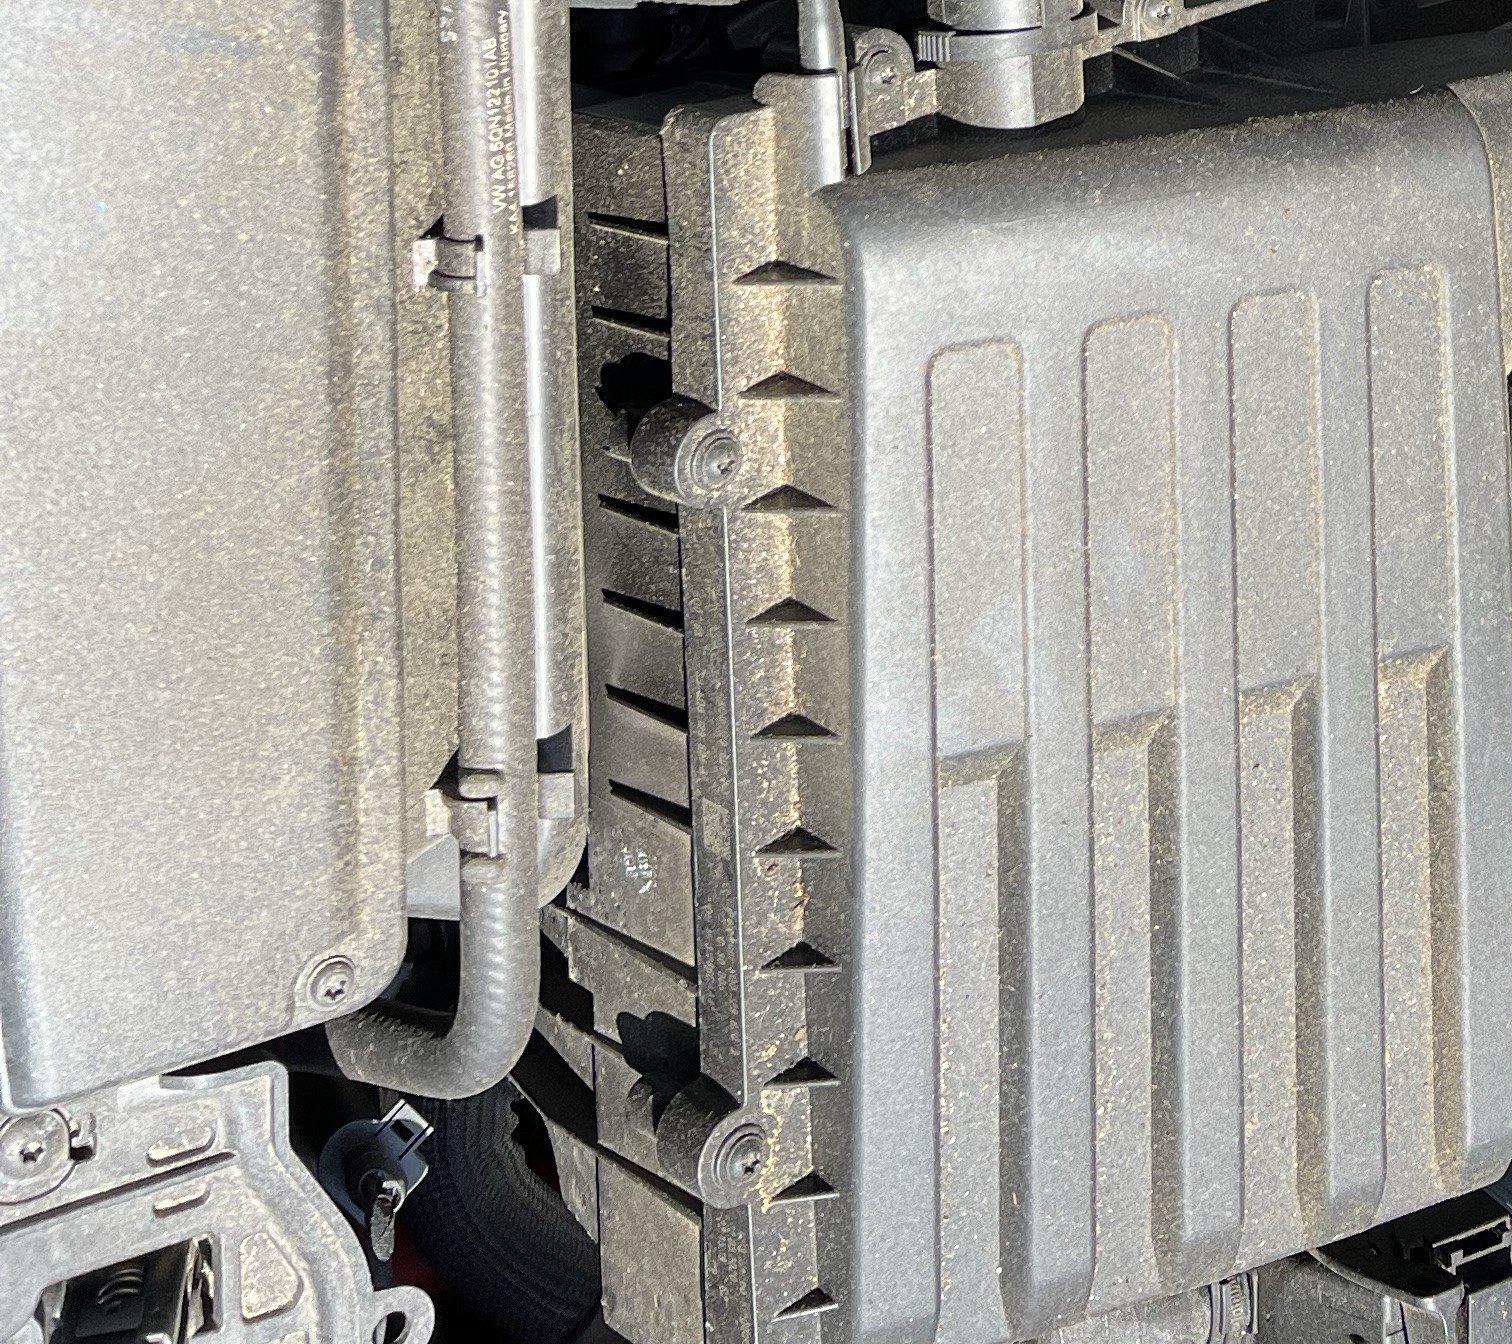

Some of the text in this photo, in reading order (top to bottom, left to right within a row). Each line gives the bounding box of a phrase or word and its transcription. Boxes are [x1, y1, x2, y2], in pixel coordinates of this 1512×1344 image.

[496, 8, 512, 72] Hungary
[489, 155, 505, 178] AG
[491, 184, 507, 213] VW
